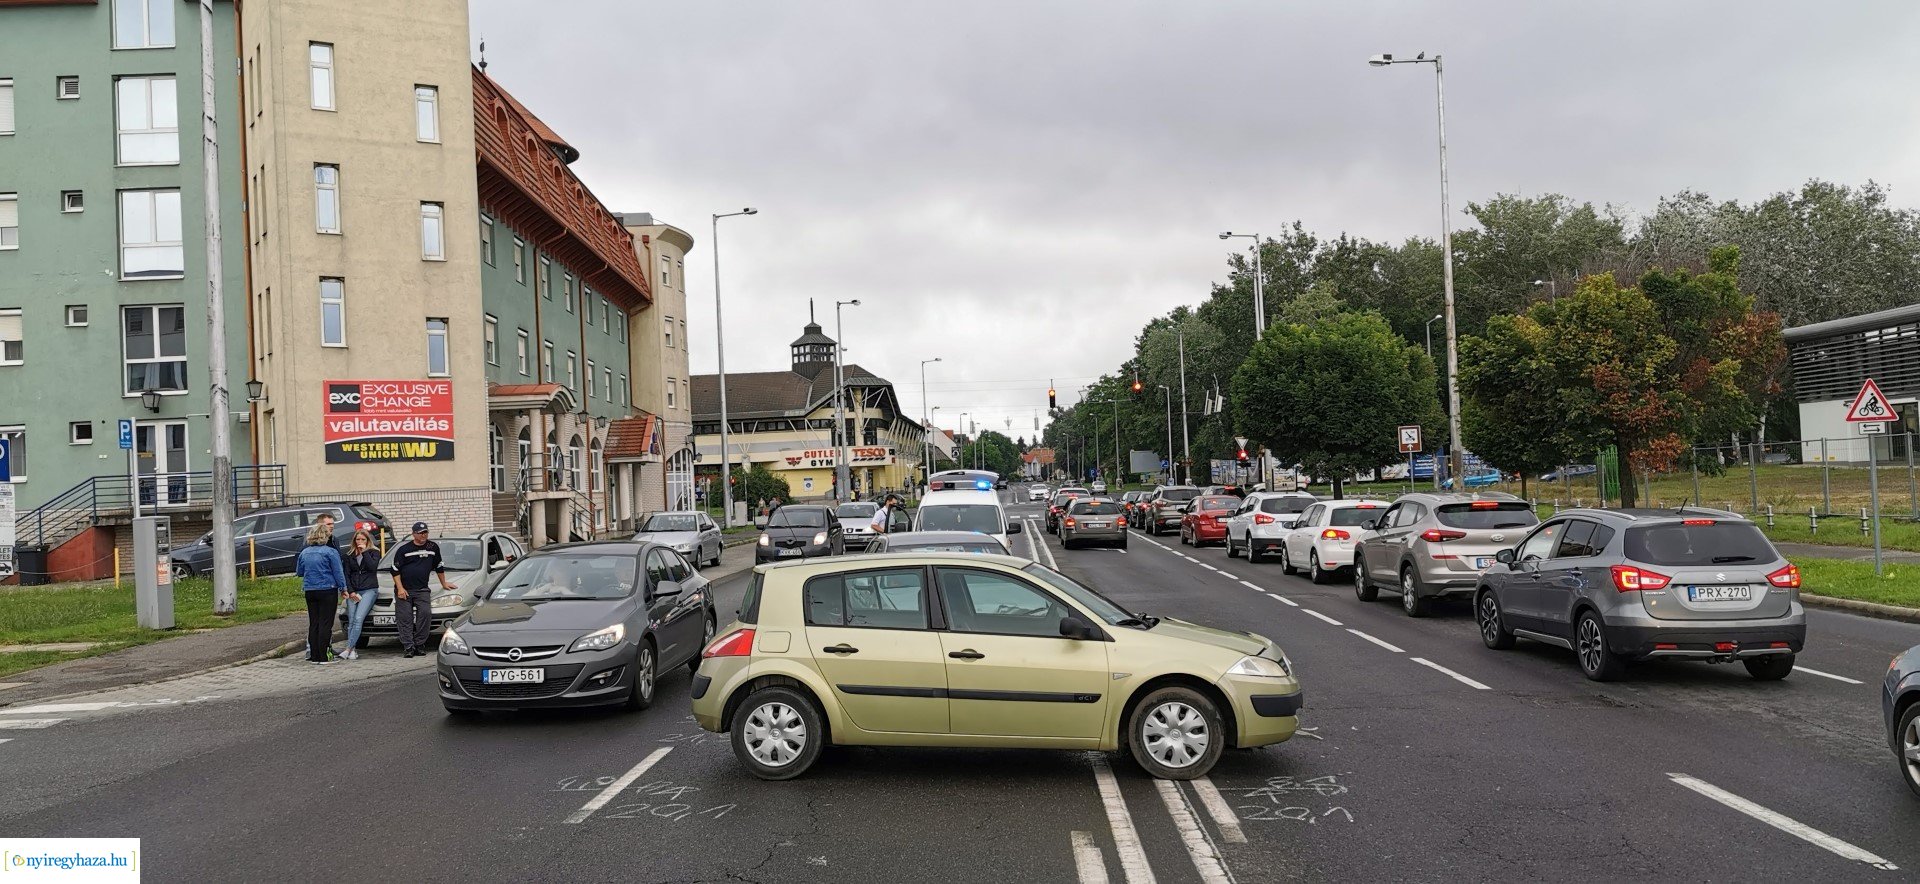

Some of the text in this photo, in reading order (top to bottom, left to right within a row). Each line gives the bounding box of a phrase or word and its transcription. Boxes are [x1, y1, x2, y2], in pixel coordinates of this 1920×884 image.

[362, 384, 449, 395] EXCLUSIVE
[329, 392, 361, 404] exc
[362, 396, 432, 407] CHANGE
[330, 416, 450, 432] valutaváltás
[120, 421, 131, 440] P
[342, 443, 399, 452] WESTERN
[852, 448, 886, 458] TESCO
[360, 450, 399, 459] UNION
[1698, 587, 1748, 598] PRX-270
[490, 670, 540, 681] PYG-561
